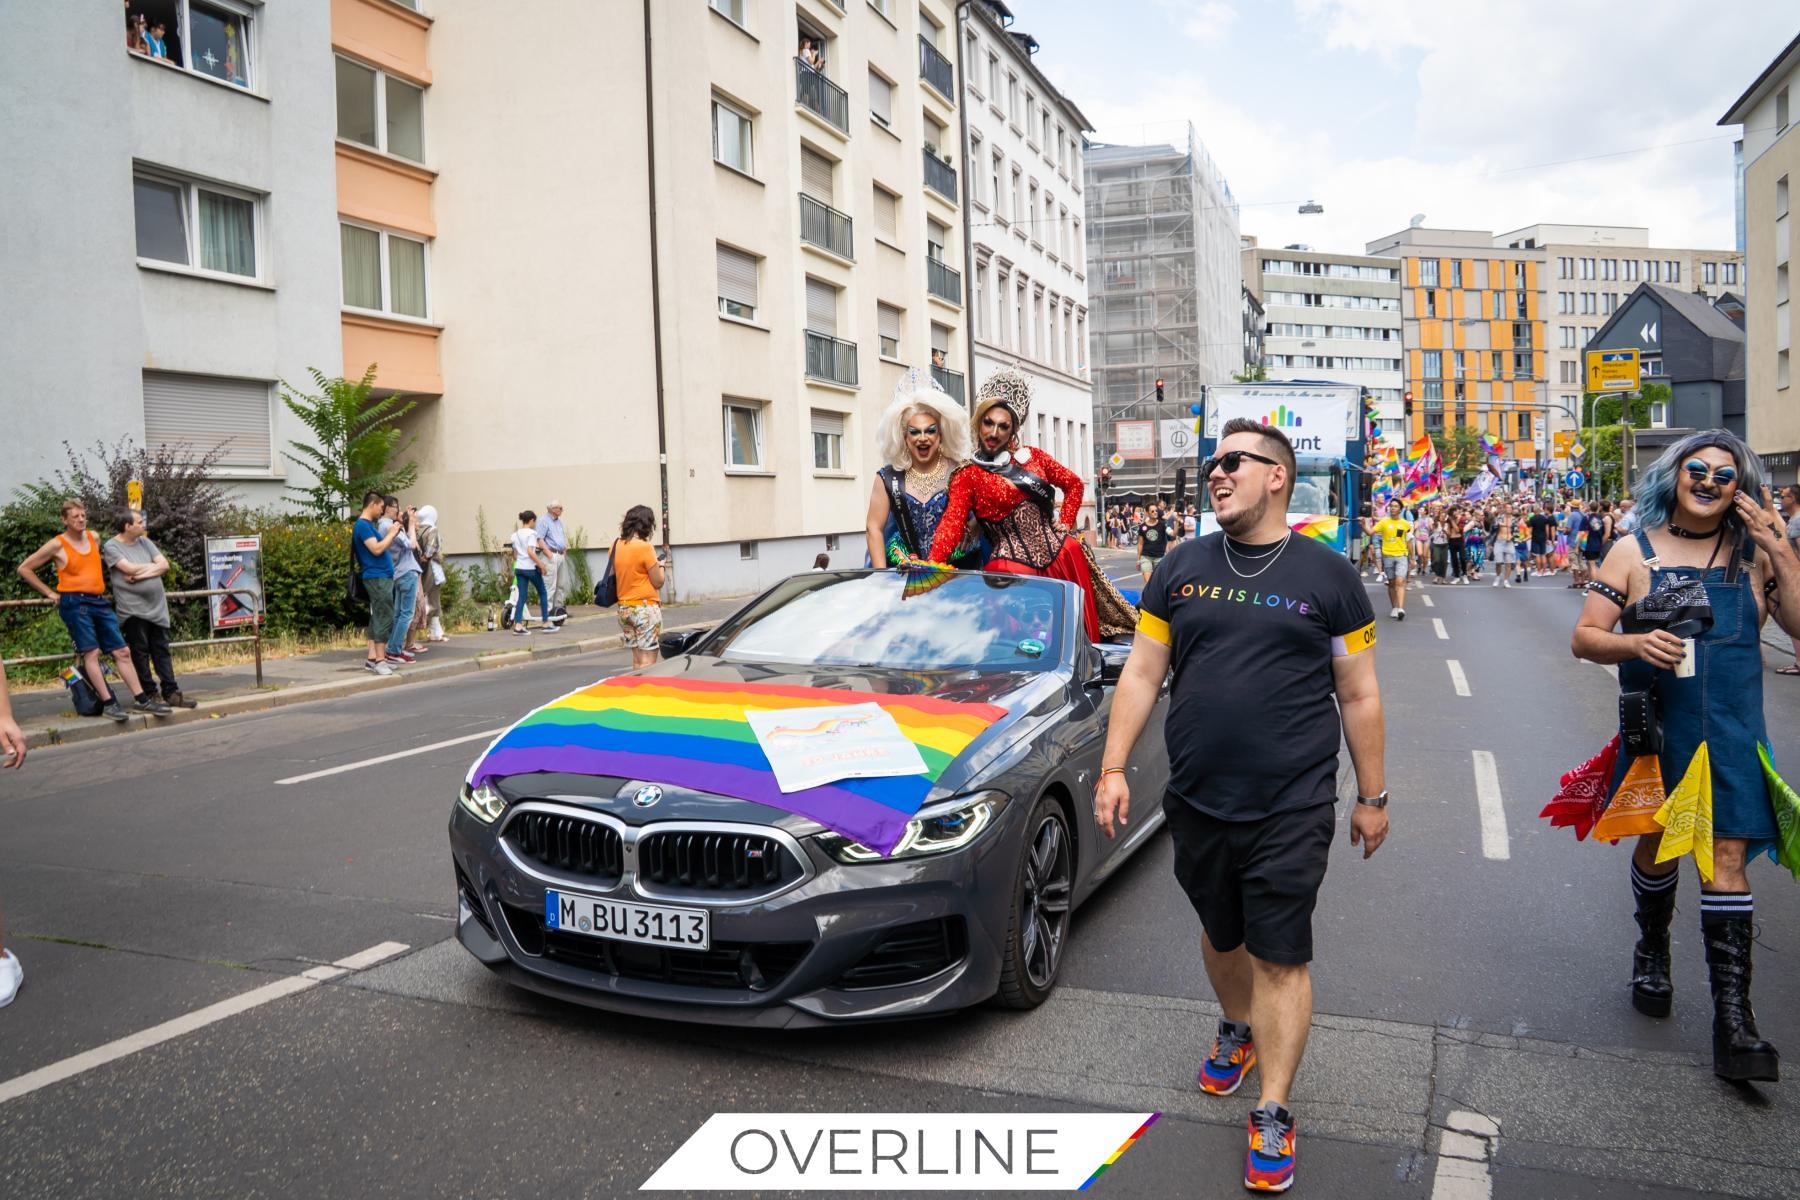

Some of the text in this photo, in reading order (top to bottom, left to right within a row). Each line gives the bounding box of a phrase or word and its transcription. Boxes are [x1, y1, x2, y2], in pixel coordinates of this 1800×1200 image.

[1289, 435, 1321, 450] unt
[1227, 589, 1246, 602] IS
[1253, 592, 1310, 615] LOVE
[1363, 628, 1376, 644] OR
[550, 912, 555, 921] D
[560, 897, 704, 945] M BU 3113
